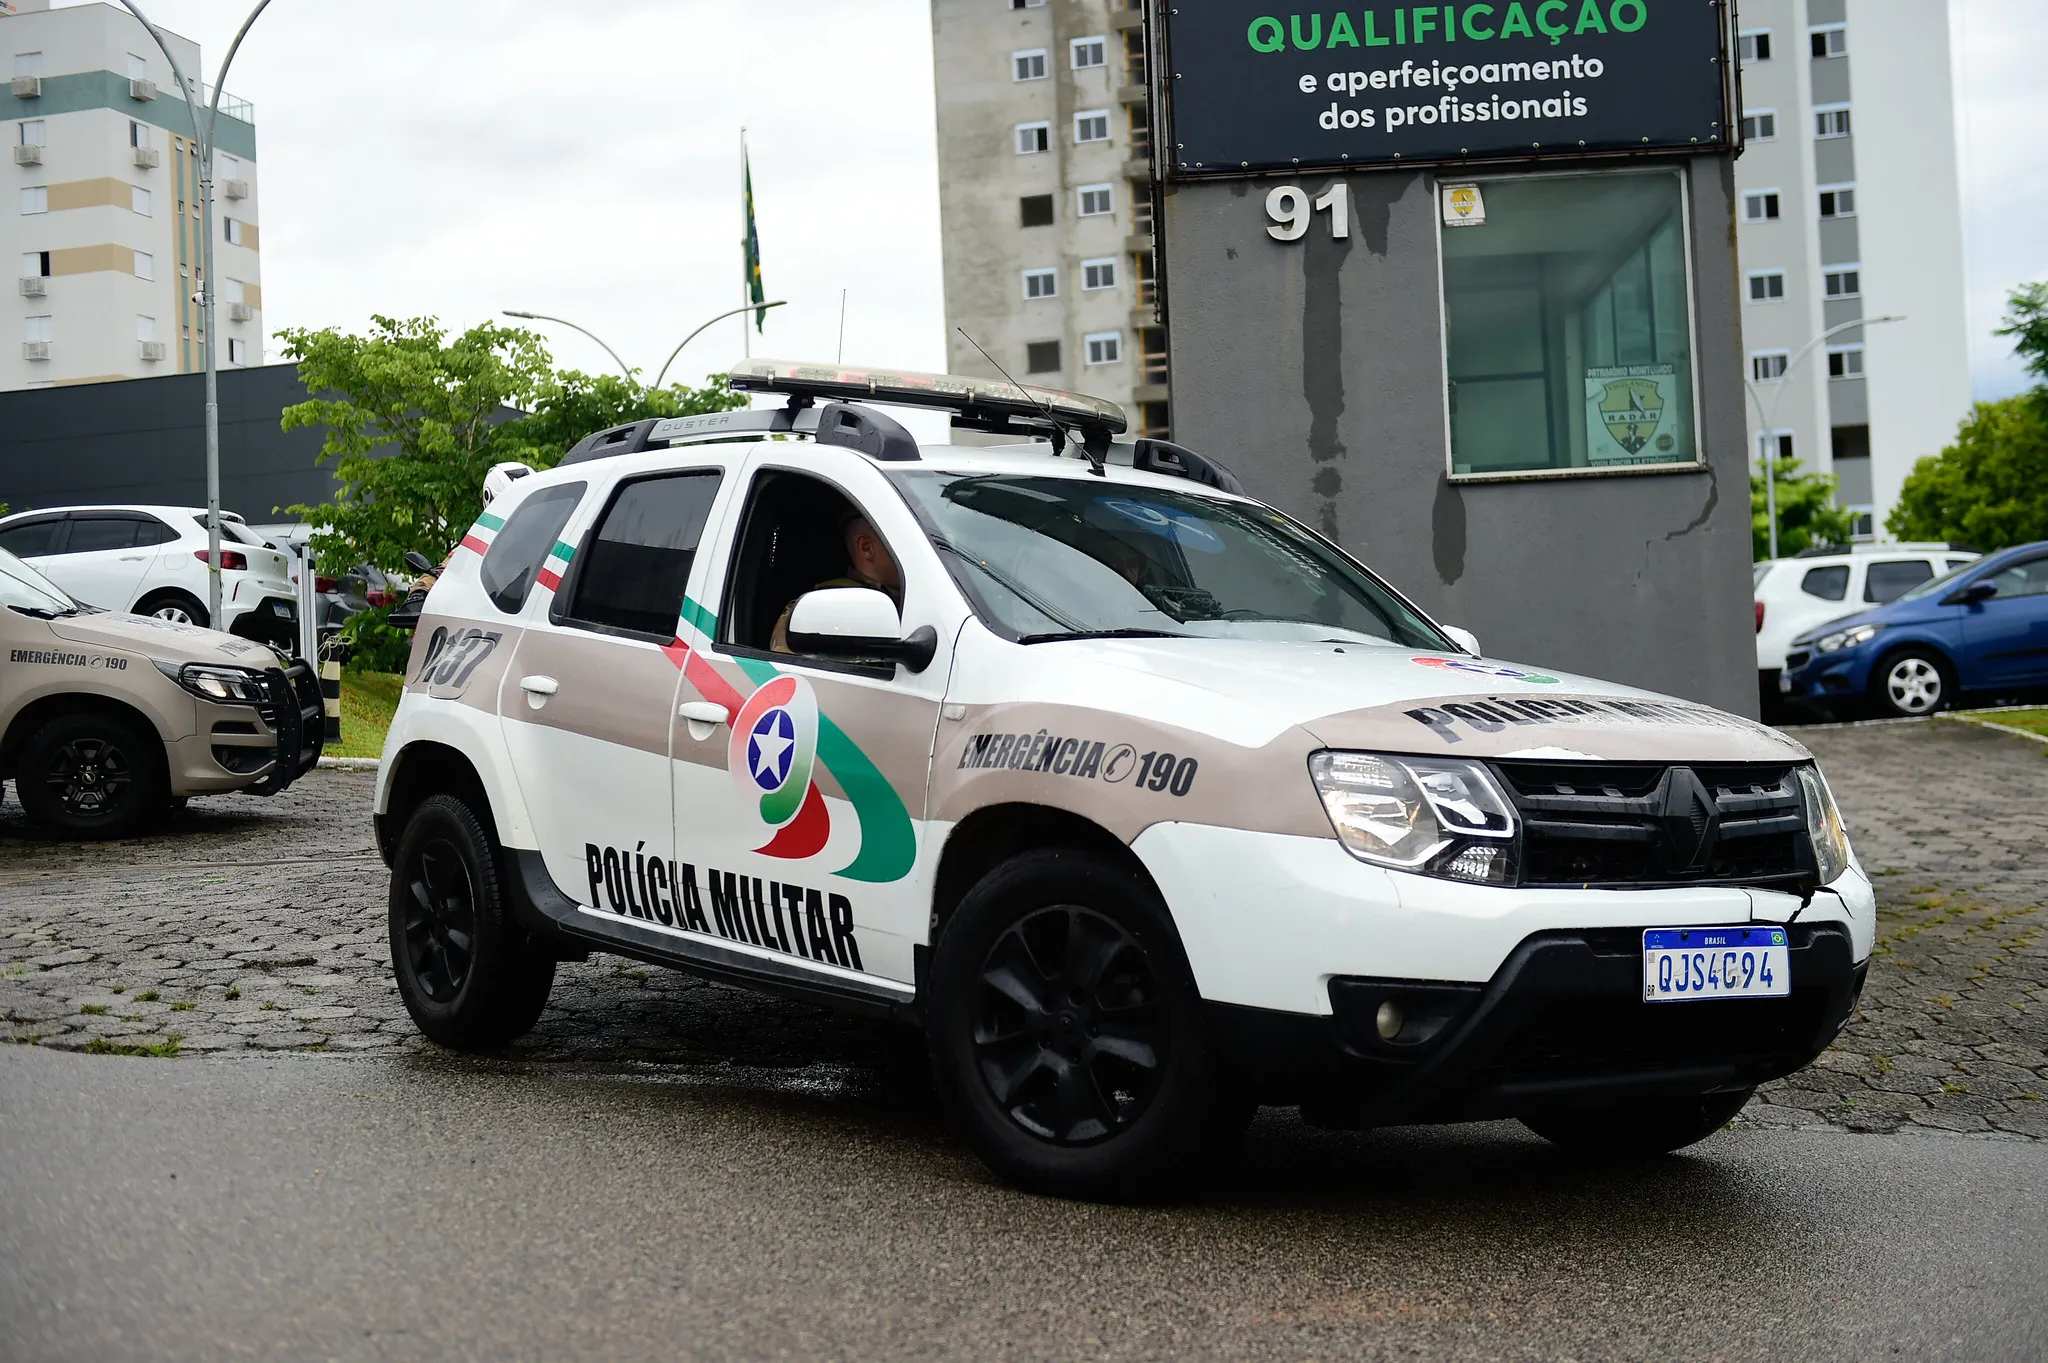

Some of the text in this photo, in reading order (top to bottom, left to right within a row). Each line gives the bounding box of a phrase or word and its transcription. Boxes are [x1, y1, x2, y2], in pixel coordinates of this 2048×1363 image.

[1298, 54, 1604, 98] e aperfeiçoamento
[1318, 90, 1588, 133] dos profissionais
[1265, 183, 1348, 241] 91
[662, 416, 730, 432] DUSTER
[1608, 412, 1657, 421] RADAR
[10, 648, 128, 671] EMERGÊNCIA 190
[957, 728, 1199, 797] EMERGÊNCIA 190
[585, 841, 864, 972] POLÍCIA MILITAR
[1704, 937, 1726, 945] BRASIL
[1659, 951, 1773, 993] QJS4C94
